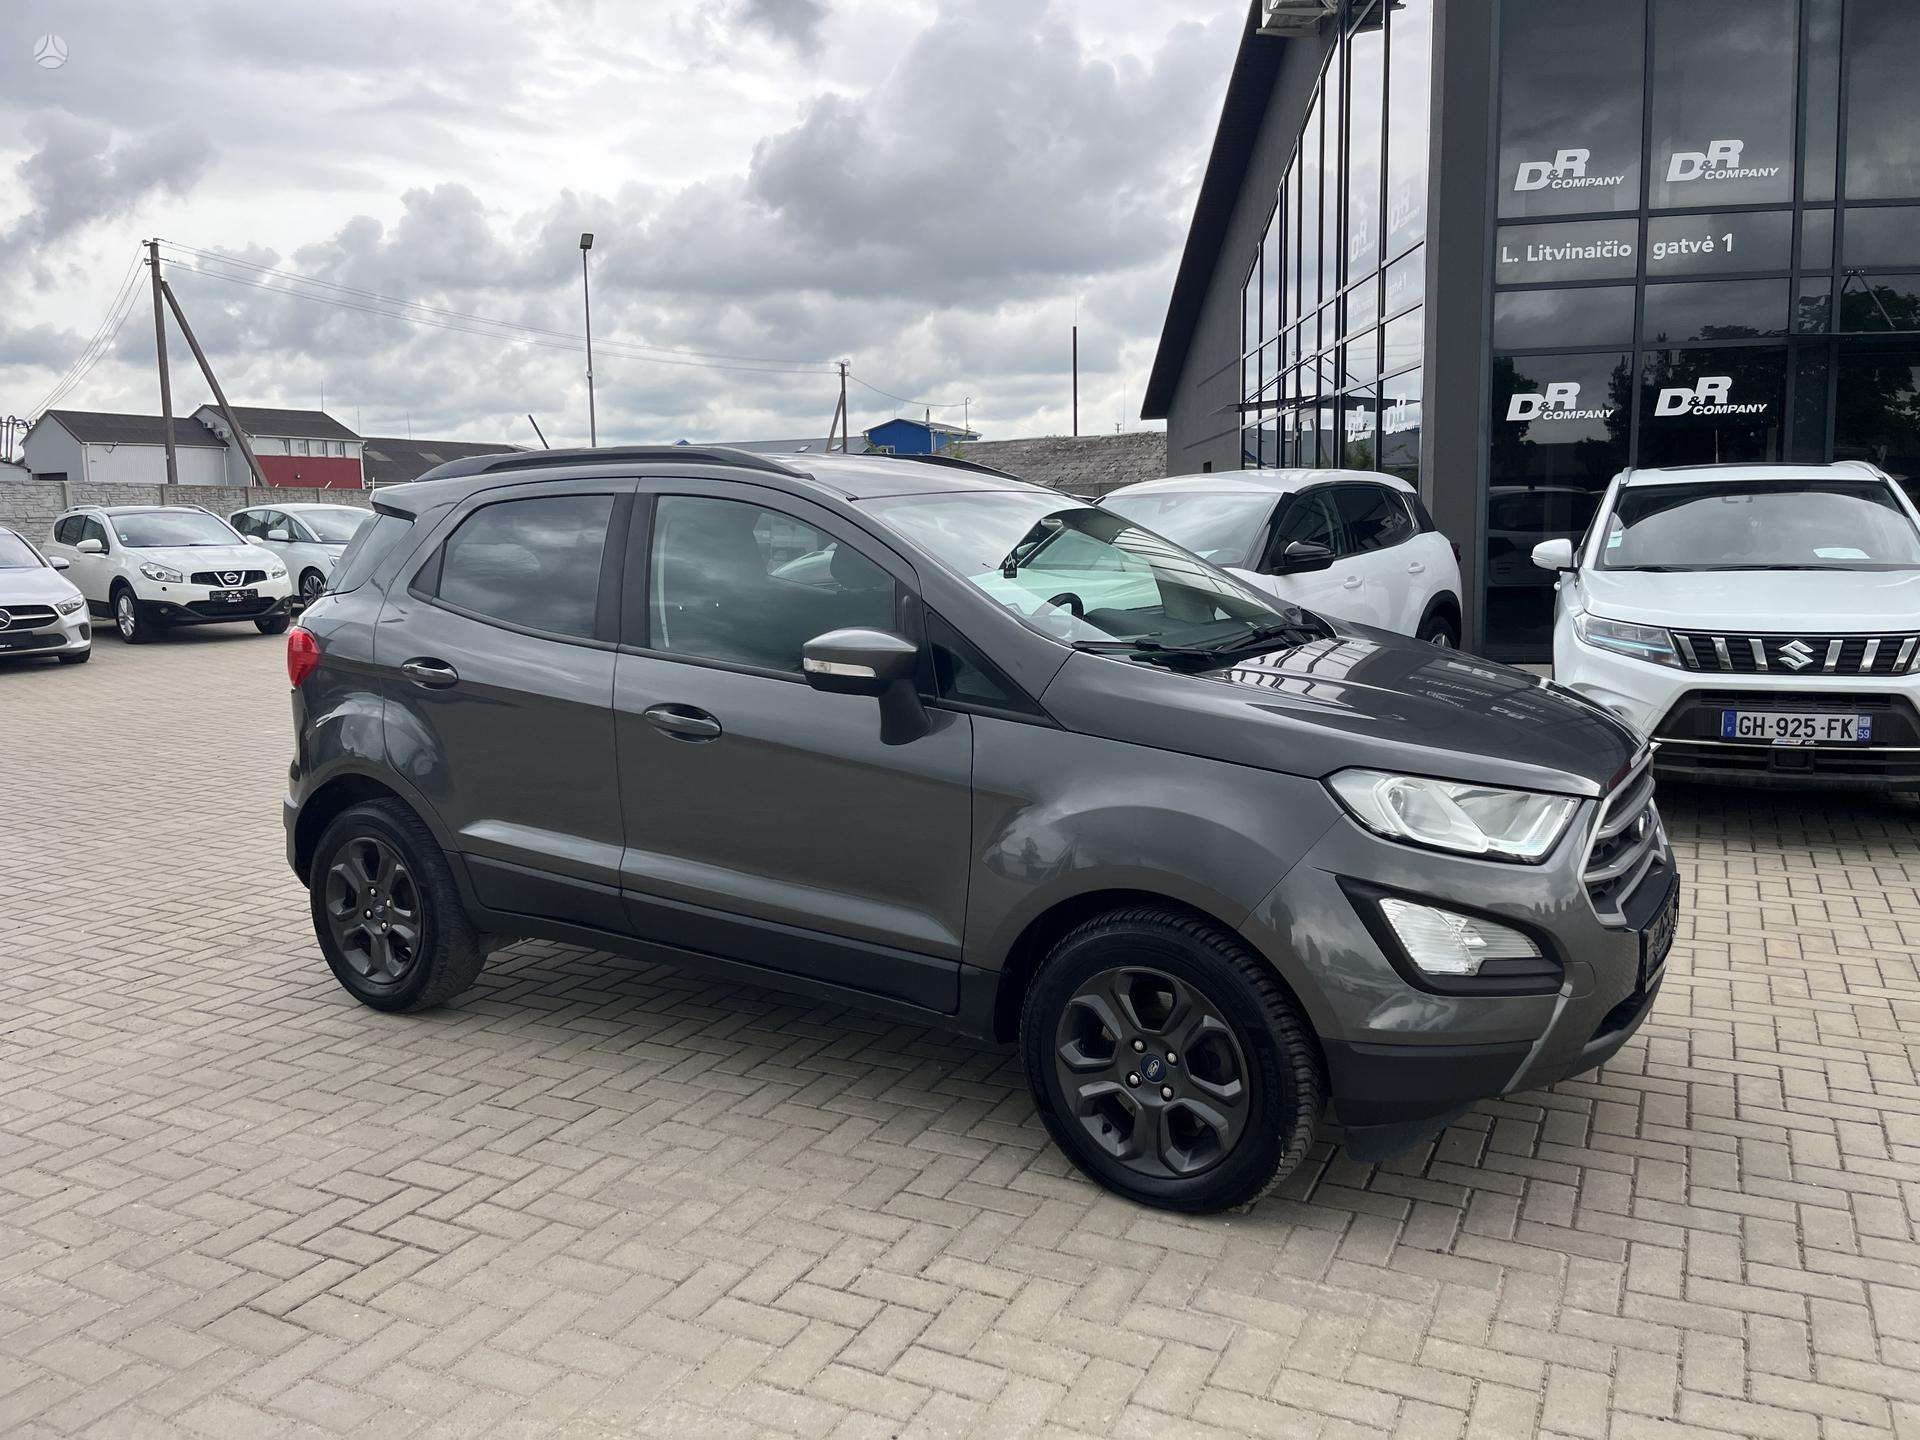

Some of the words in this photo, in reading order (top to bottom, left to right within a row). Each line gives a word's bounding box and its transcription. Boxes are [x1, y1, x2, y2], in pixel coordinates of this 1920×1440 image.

[1513, 148, 1590, 191] D&R
[1666, 139, 1744, 182] D&R
[1551, 175, 1624, 189] COMPANY
[1704, 167, 1779, 180] COMPANY
[1502, 246, 1519, 263] L.
[1527, 240, 1632, 262] Litvinaičio
[1652, 235, 1715, 260] gatvė
[1721, 233, 1733, 252] 1
[1506, 382, 1580, 421] D&R
[1654, 376, 1732, 417] D&R
[1542, 409, 1614, 420] COMPANY
[1692, 403, 1768, 415] COMPANY
[1858, 729, 1870, 739] 59
